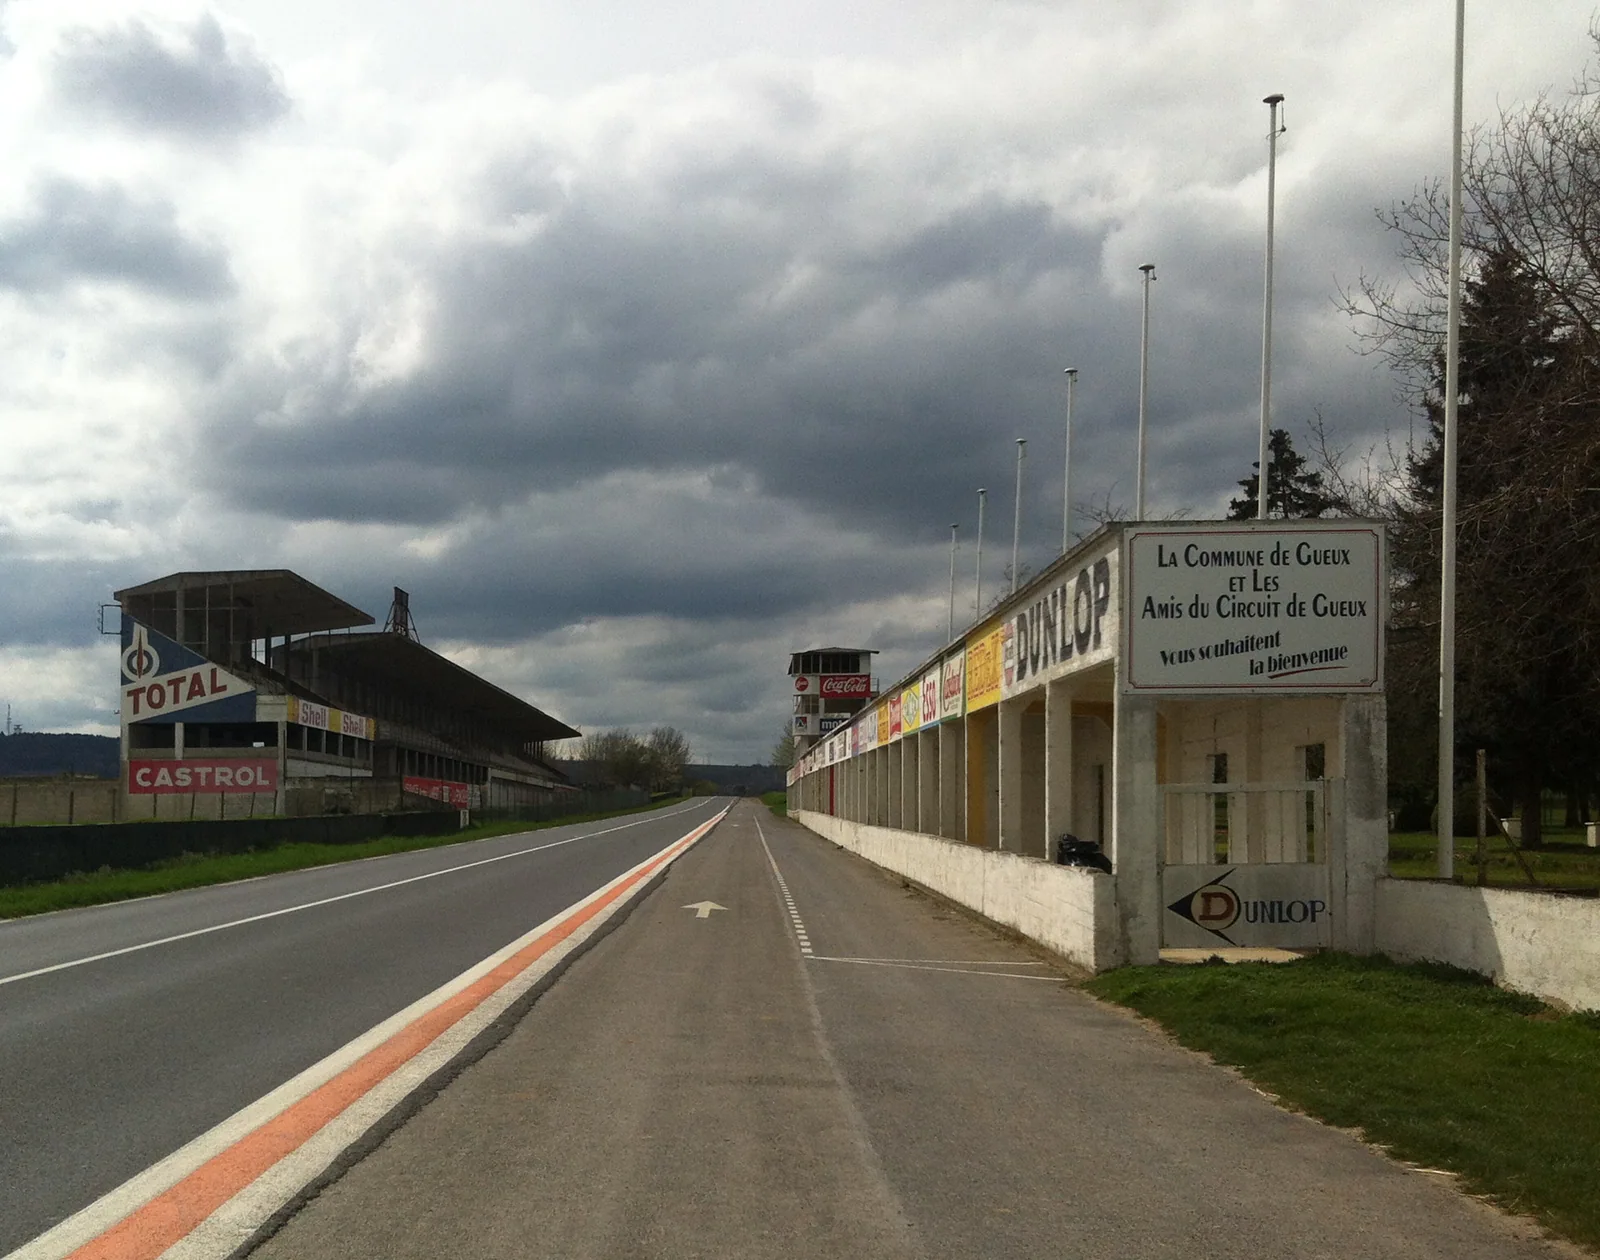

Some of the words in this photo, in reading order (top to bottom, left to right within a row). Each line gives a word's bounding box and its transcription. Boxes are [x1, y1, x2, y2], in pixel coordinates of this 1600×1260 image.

[1184, 542, 1264, 568] COMMUNE
[1296, 542, 1350, 566] GUEUX
[1016, 556, 1111, 682] DUNLOP
[1312, 593, 1367, 618] GUEUX
[1160, 647, 1196, 667] Vous
[1198, 630, 1282, 661] souhaitent
[1249, 658, 1264, 676] la
[1267, 645, 1348, 673] bienvenue
[126, 667, 227, 715] TOTAL
[302, 703, 326, 728] Shell
[343, 714, 364, 736] Shell
[136, 766, 270, 787] CASTROL
